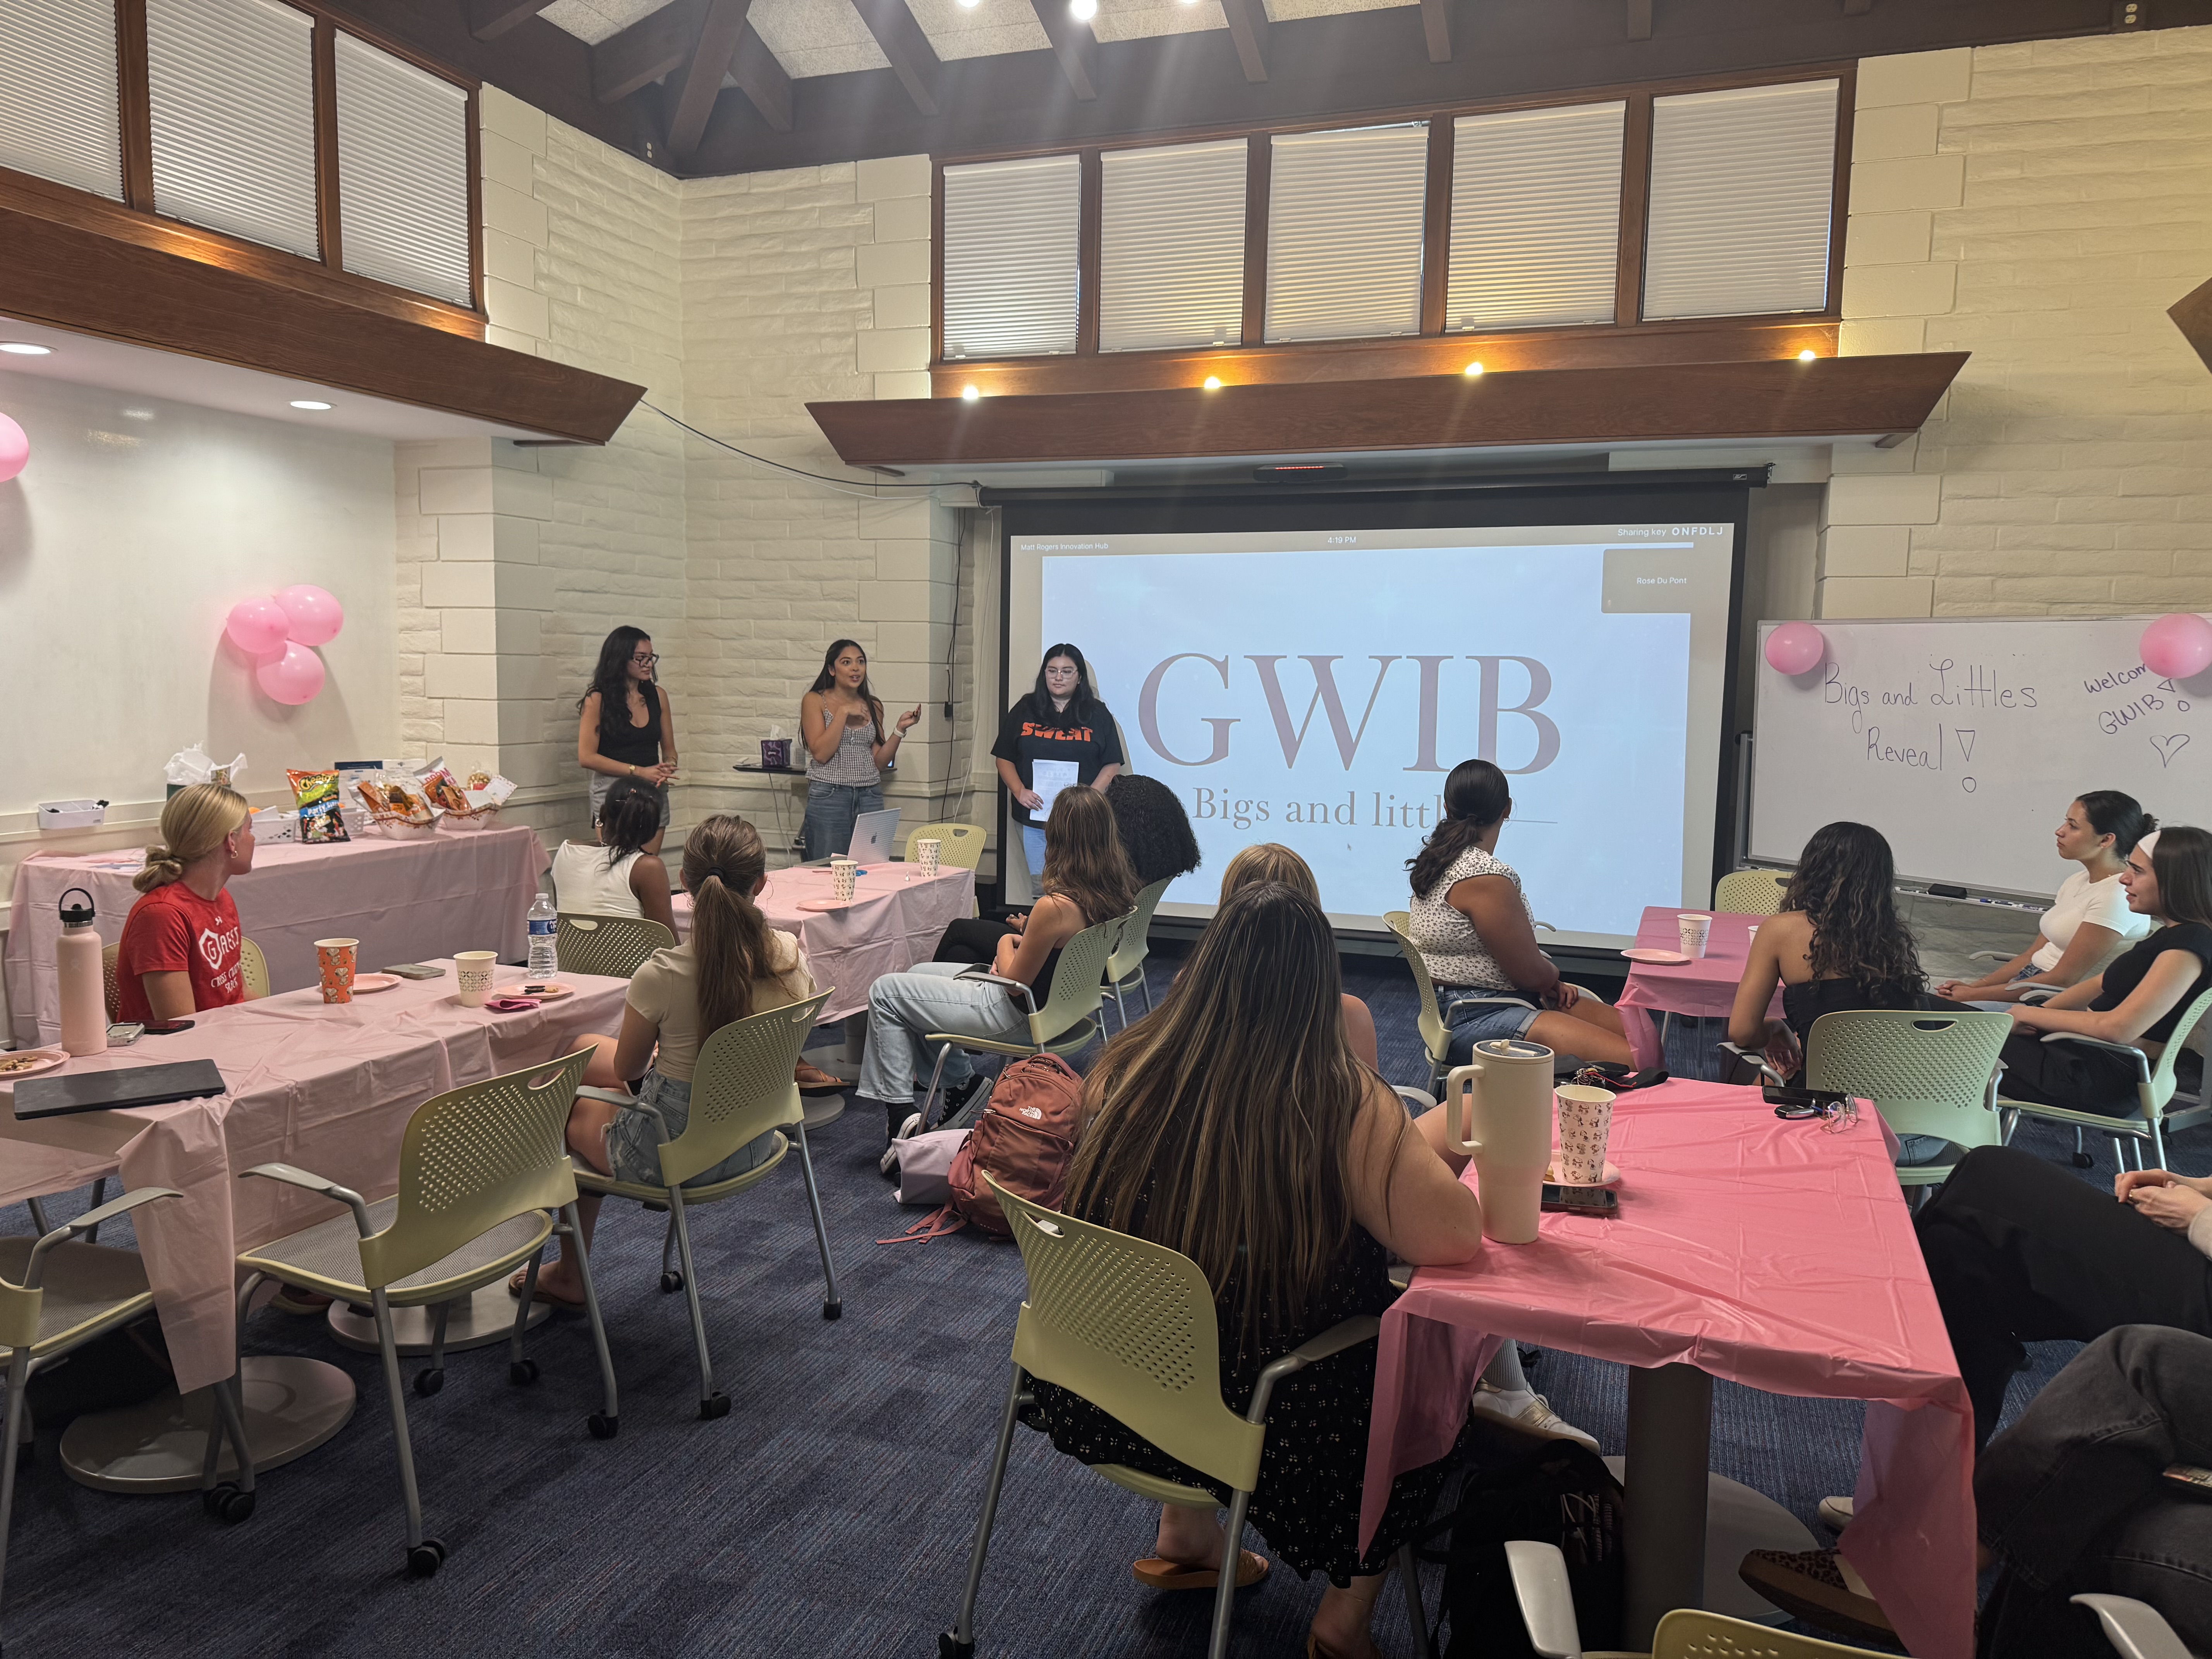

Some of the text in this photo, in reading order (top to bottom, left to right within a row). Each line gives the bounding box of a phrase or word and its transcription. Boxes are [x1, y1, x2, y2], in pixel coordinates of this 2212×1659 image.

[1618, 528, 1649, 537] Sharing
[1652, 528, 1666, 537] key
[1825, 659, 2037, 734] Bigs and Littles
[2084, 663, 2146, 693] Welcom
[1138, 653, 1561, 775] GWIB
[1192, 787, 1444, 830] Bigs and littl
